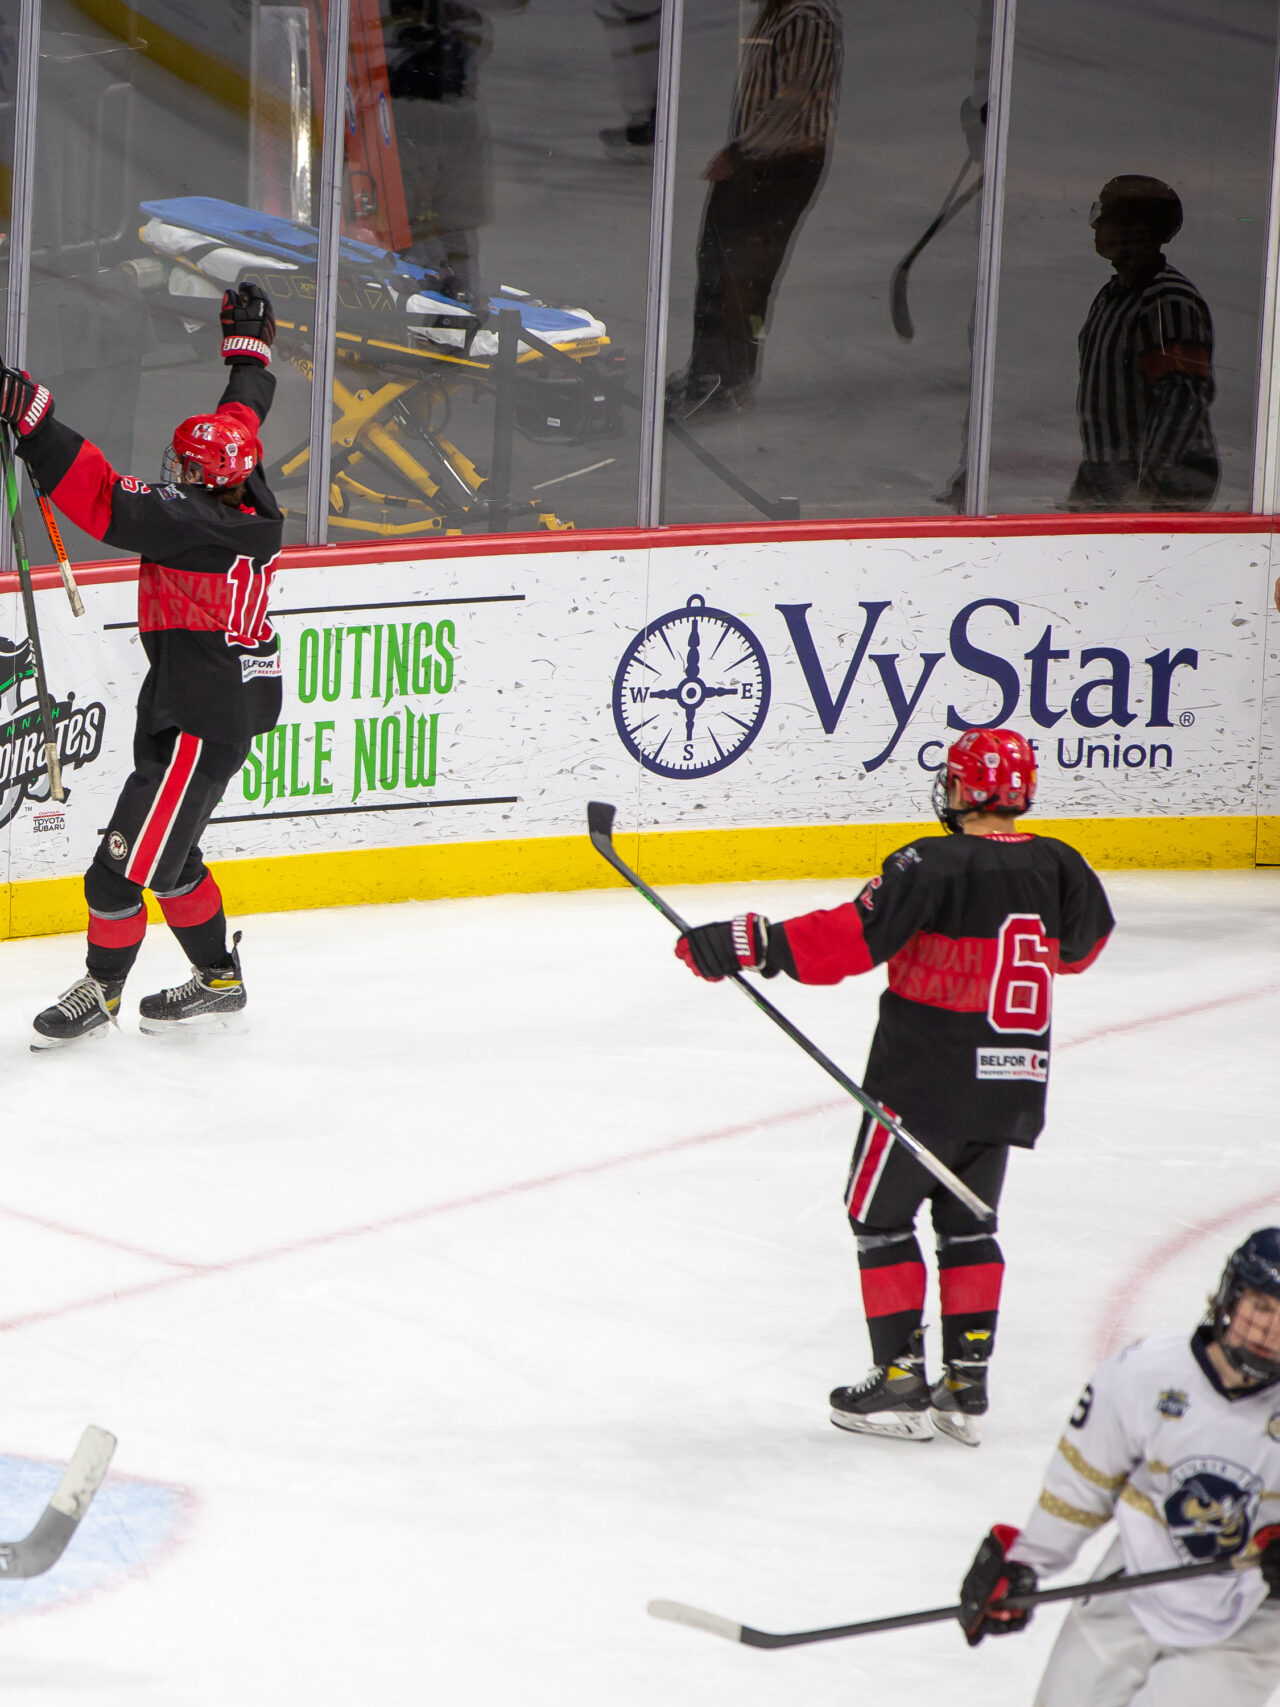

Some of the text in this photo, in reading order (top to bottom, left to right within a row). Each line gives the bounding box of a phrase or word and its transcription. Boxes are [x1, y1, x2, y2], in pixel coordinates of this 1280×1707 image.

[297, 619, 457, 709] OUTINGS
[242, 705, 441, 808] SALE NOW
[1056, 733, 1173, 770] Union
[32, 817, 65, 826] TOYOTA
[32, 824, 66, 834] SUBARU
[987, 913, 1051, 1036] 6
[980, 1054, 1027, 1068] BELFOR
